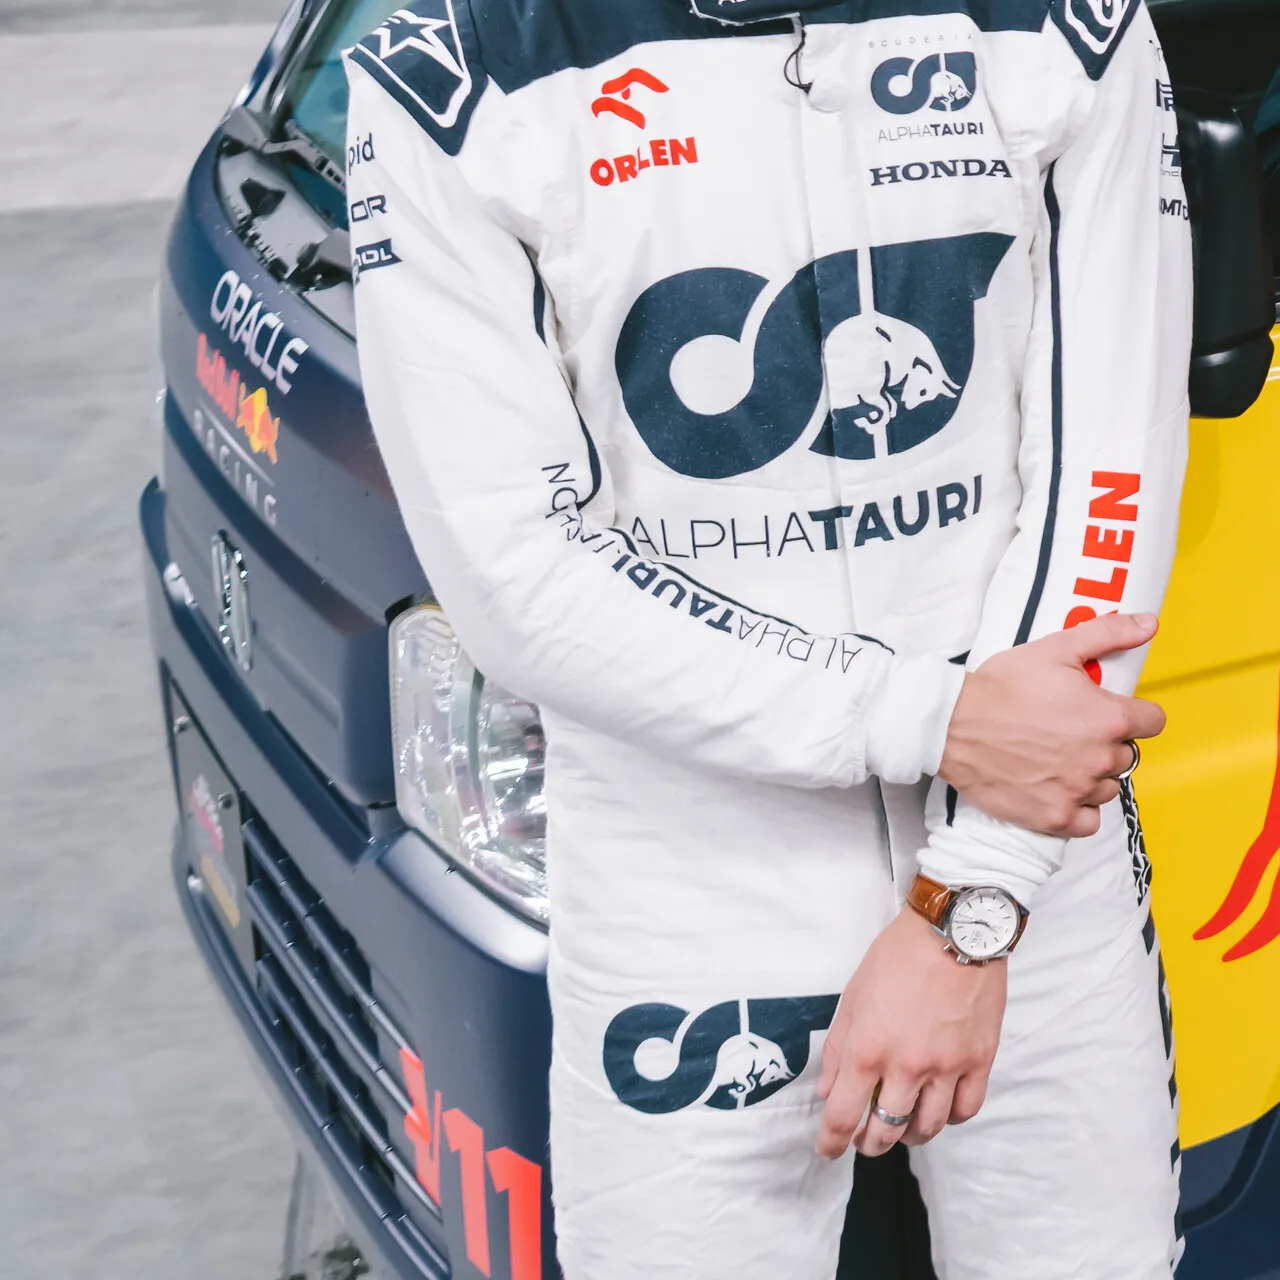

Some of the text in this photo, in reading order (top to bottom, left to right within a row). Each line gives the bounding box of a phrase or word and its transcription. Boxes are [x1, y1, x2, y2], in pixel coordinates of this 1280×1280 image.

[867, 33, 974, 49] SCUDERIA
[877, 121, 985, 143] ALPHATAURI
[590, 136, 699, 187] ORLEN
[870, 158, 1013, 187] HONDA
[210, 269, 310, 396] ORACLE
[631, 473, 983, 560] ALPHATAURI
